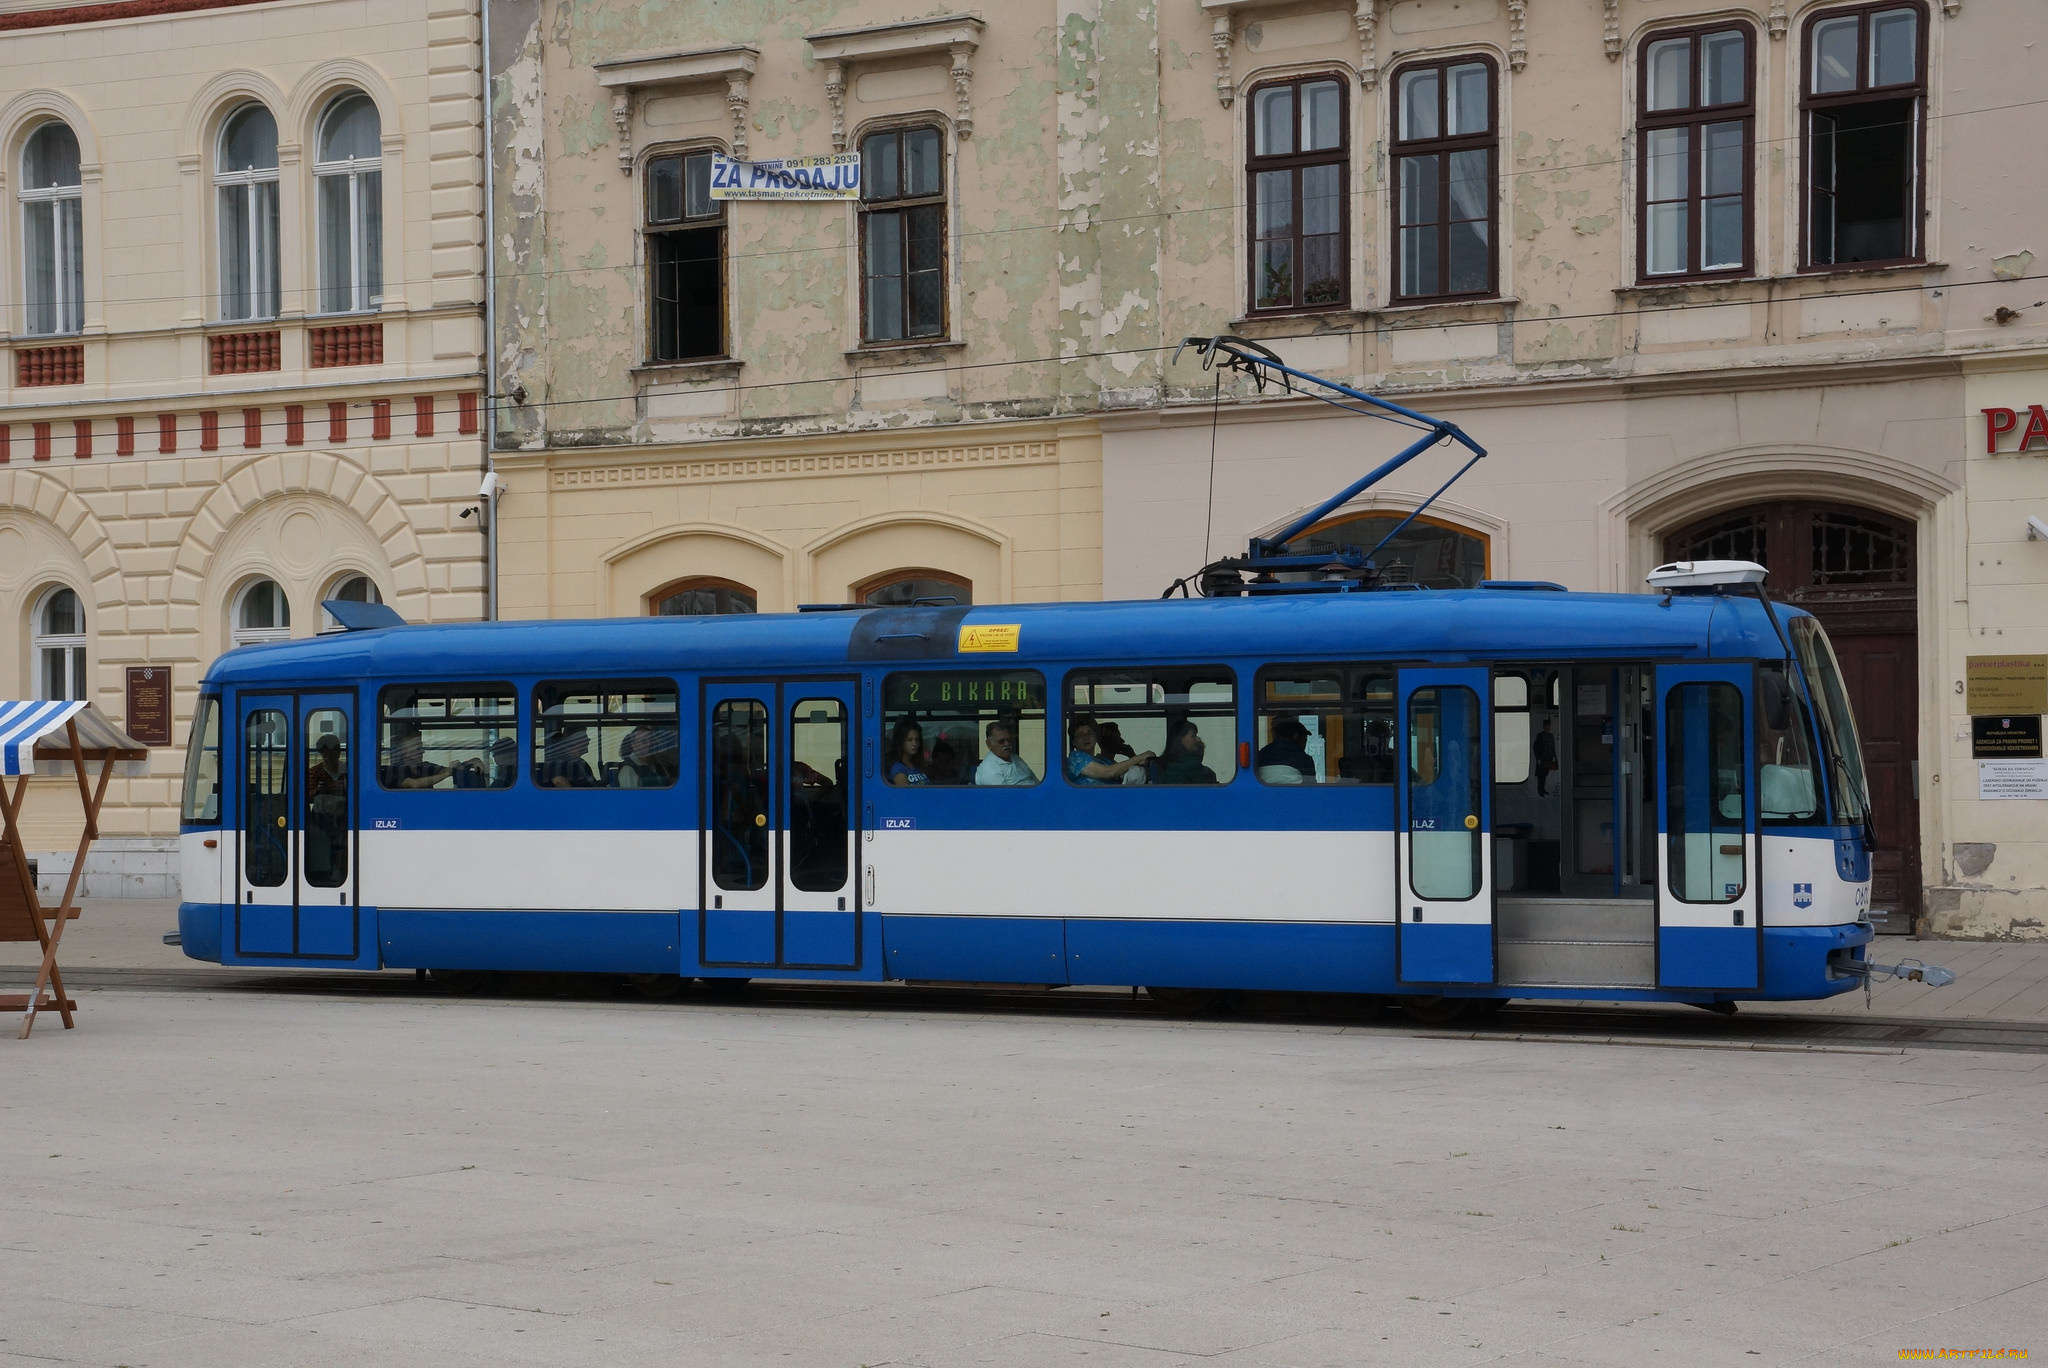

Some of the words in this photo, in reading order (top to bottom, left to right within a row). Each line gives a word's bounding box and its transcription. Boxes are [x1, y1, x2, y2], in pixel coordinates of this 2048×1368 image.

[786, 159, 804, 168] 091
[813, 157, 831, 166] 283
[834, 154, 858, 164] 2930
[712, 163, 742, 188] ZA
[750, 163, 859, 190] PRODAJU
[724, 190, 846, 198] www.tasman-nekretnine.hr
[910, 682, 919, 702] 2
[941, 680, 1028, 701] BIKARA
[1955, 680, 1964, 694] 3
[375, 820, 397, 829] IZLAZ
[886, 819, 910, 828] IZLAZ
